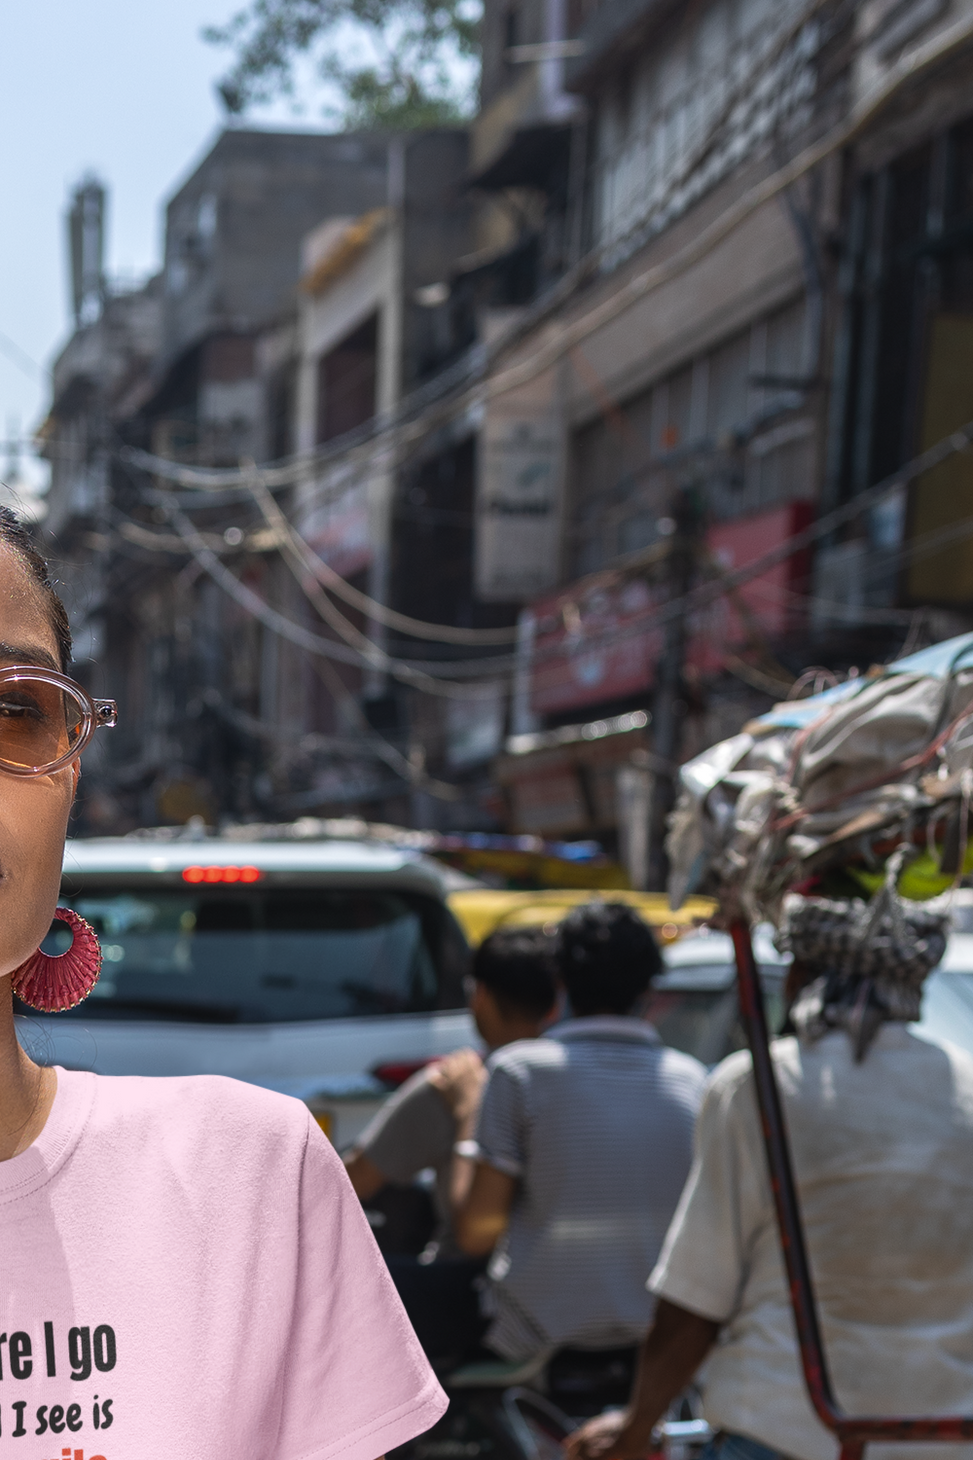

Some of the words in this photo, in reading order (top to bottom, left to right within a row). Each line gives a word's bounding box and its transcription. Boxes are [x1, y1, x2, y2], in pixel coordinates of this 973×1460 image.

[43, 1321, 57, 1378] I
[67, 1324, 117, 1382] go
[11, 1400, 27, 1438] I
[35, 1403, 83, 1437] see
[92, 1394, 114, 1430] is
